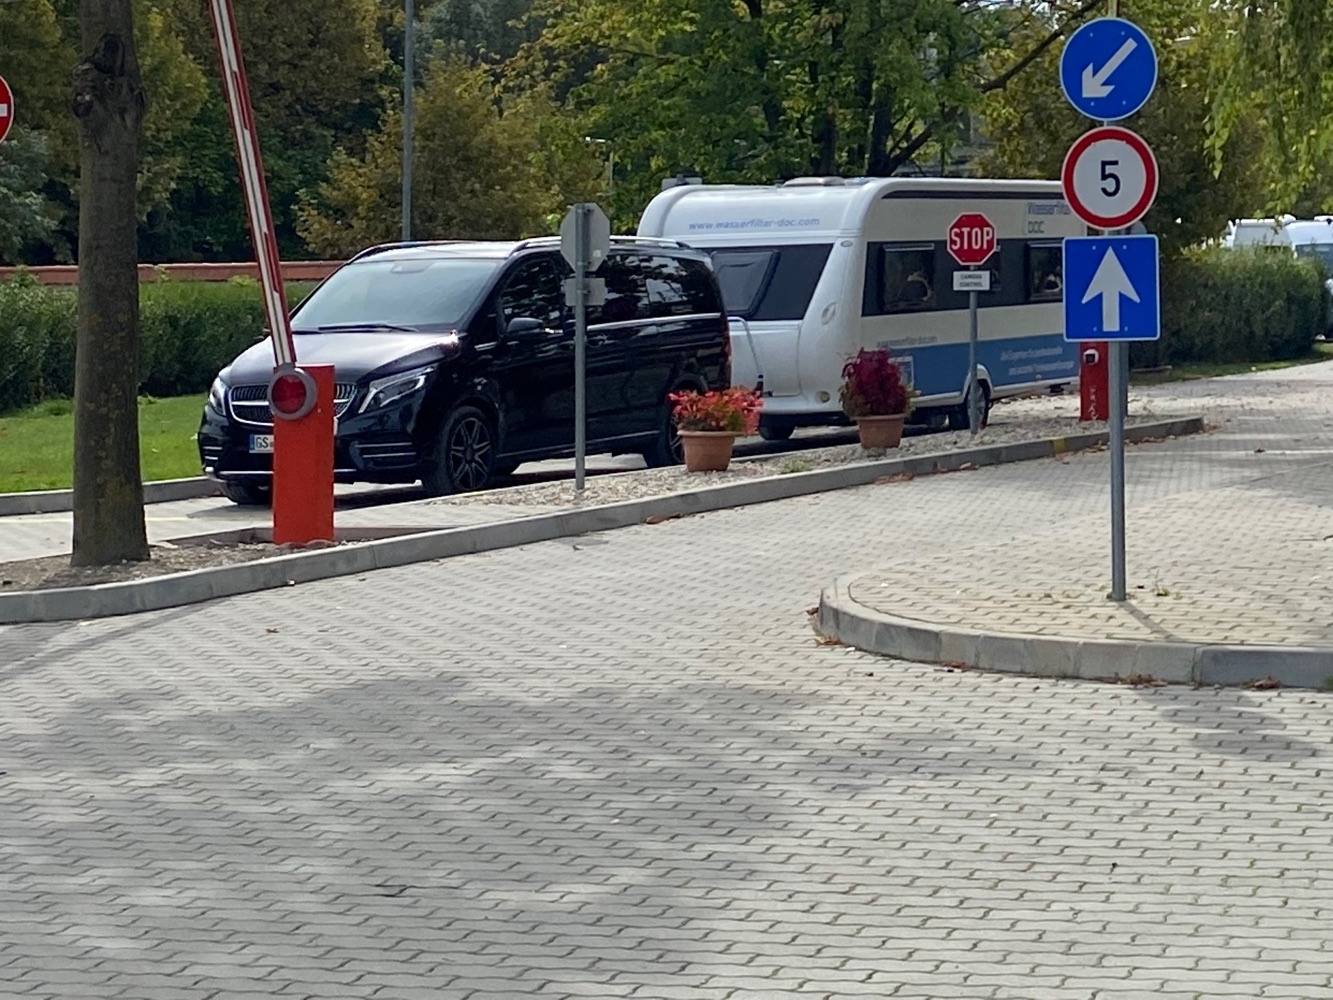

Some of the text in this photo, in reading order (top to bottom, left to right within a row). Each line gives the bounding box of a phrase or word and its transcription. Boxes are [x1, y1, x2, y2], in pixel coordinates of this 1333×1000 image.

[1100, 160, 1121, 197] 5
[689, 217, 820, 231] www.wasserfilter-doc.com
[951, 227, 992, 250] STOP
